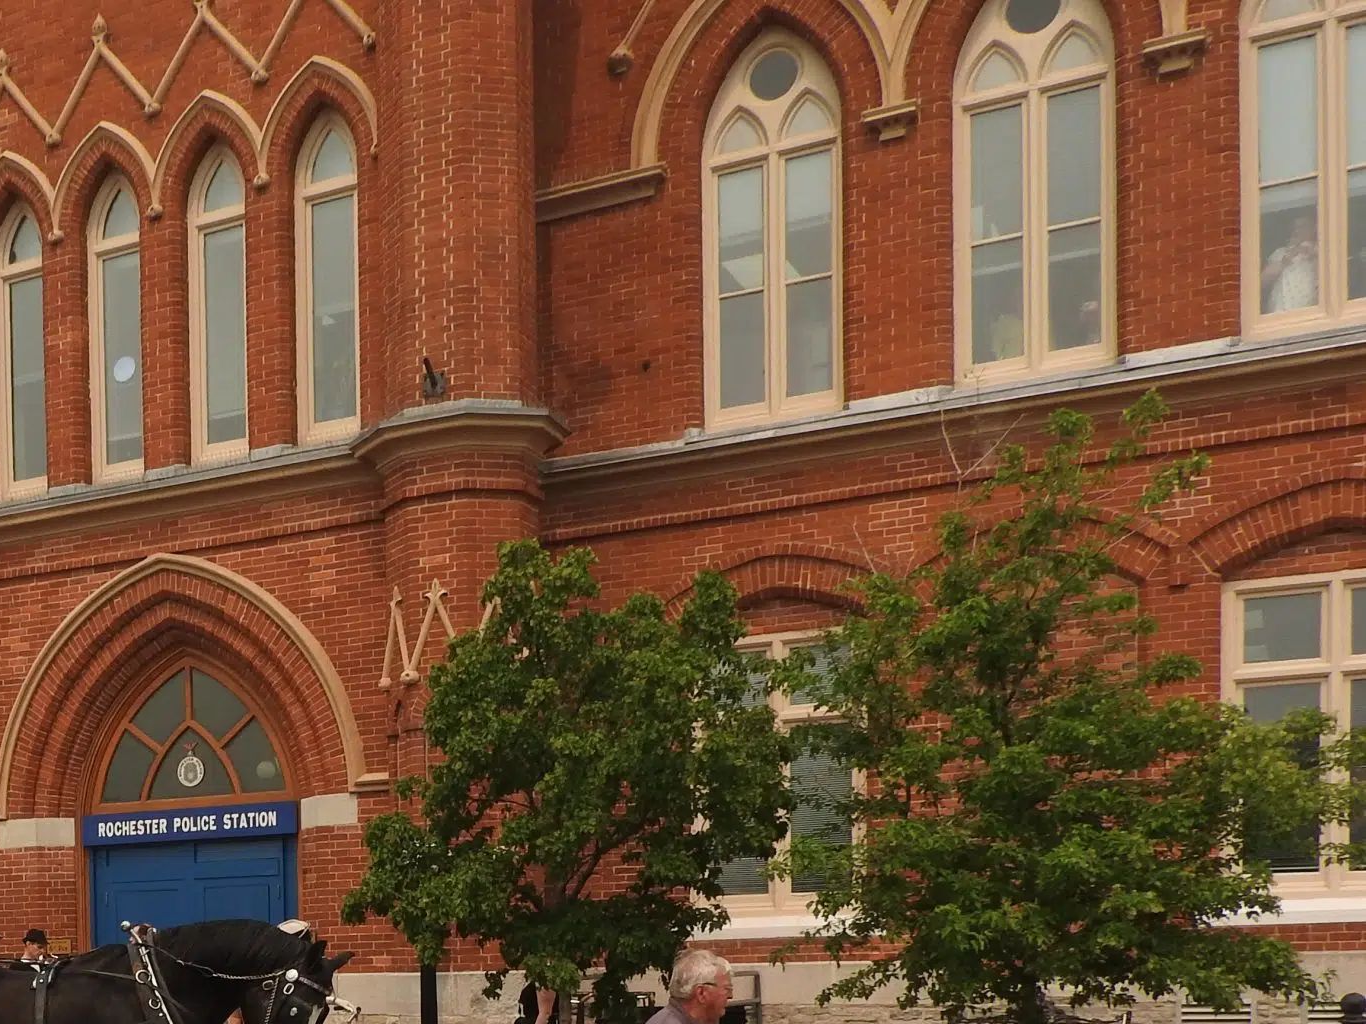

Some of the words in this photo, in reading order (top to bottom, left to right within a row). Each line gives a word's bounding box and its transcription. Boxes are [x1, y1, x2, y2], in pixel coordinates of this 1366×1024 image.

[98, 818, 167, 838] ROCHESTER
[173, 815, 217, 833] POLICE
[223, 811, 277, 830] STATION
